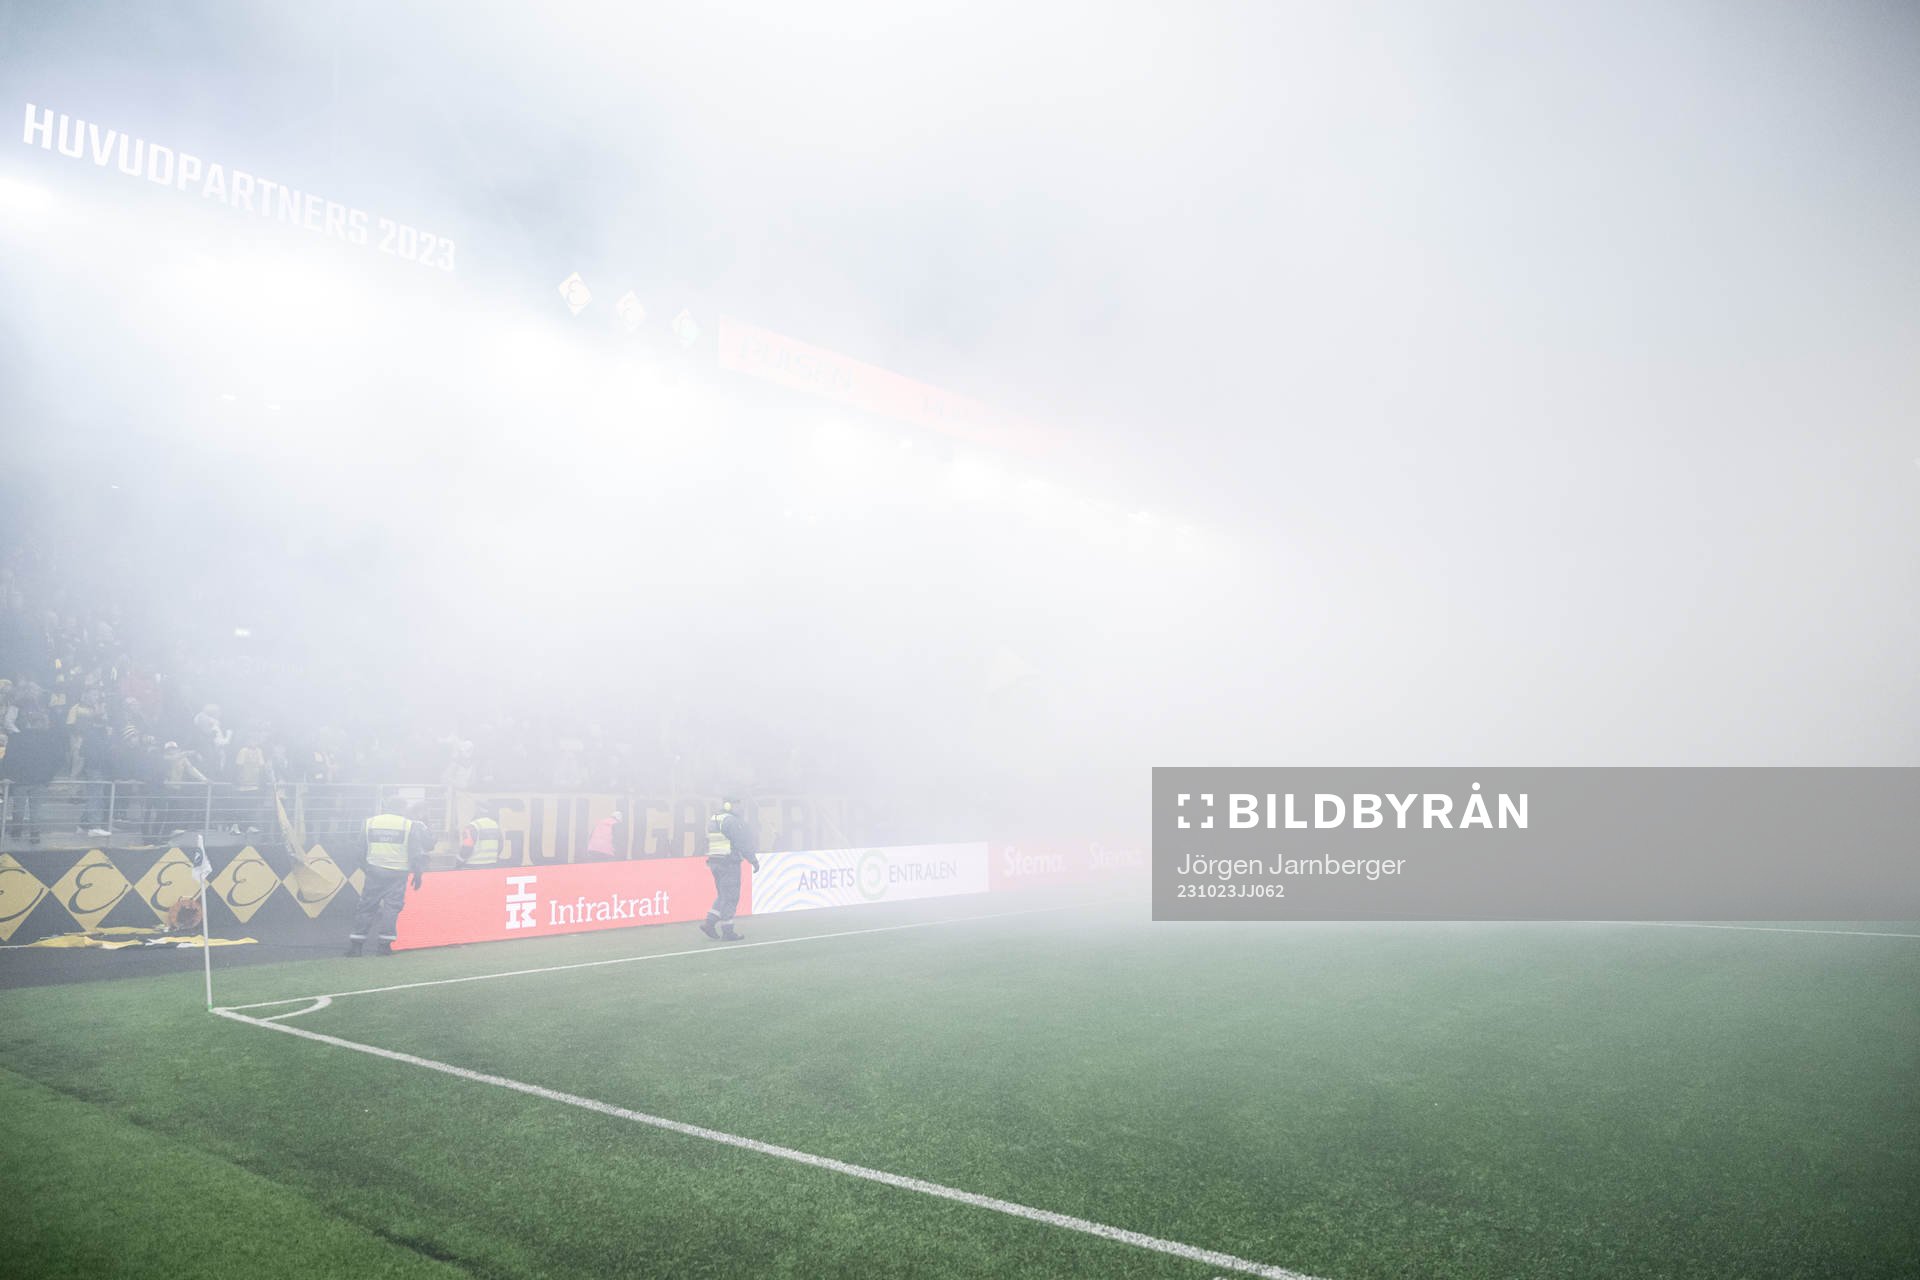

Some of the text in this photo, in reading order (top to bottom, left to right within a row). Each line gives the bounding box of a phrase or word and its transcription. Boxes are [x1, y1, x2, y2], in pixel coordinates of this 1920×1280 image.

[23, 103, 456, 273] HUVUDPARTNERS 2023
[549, 890, 670, 926] Infrakraft
